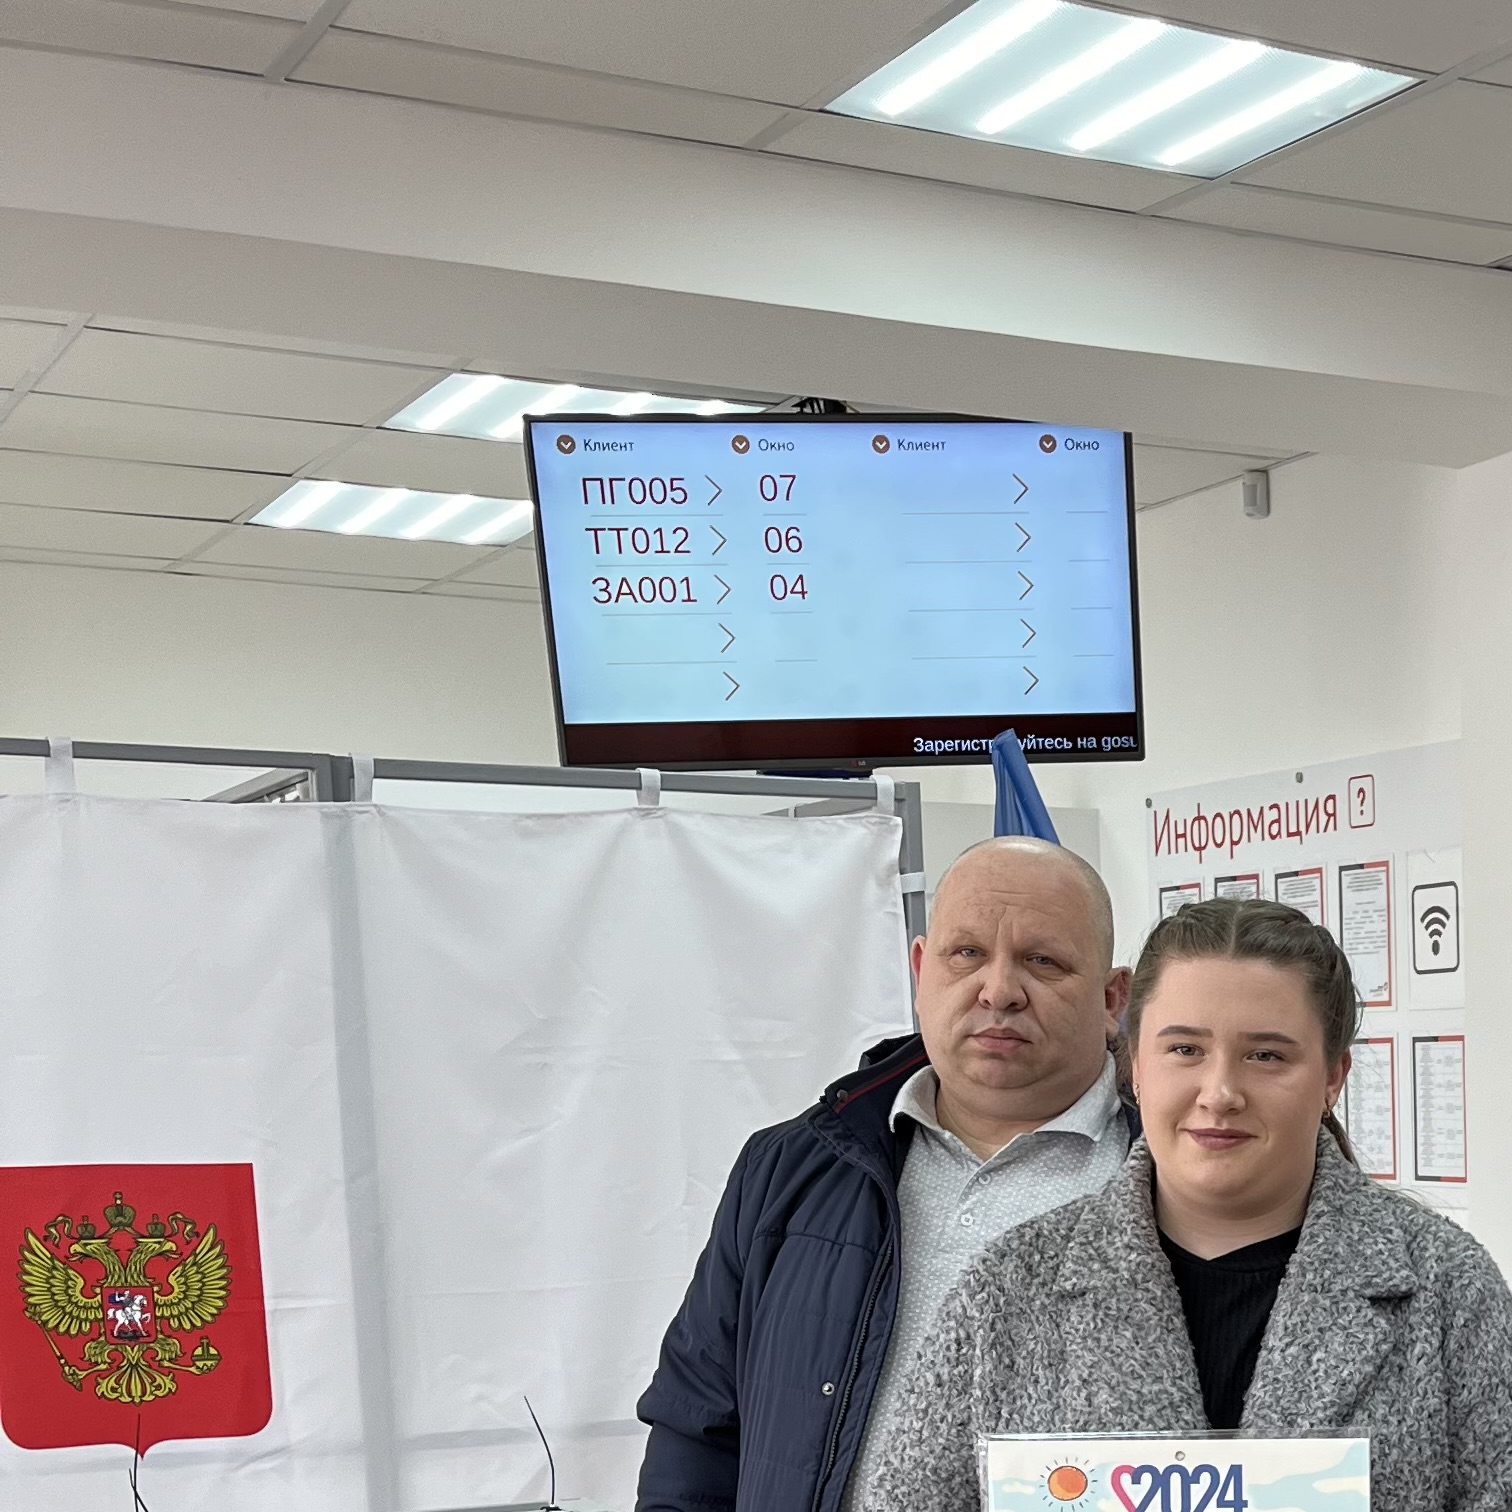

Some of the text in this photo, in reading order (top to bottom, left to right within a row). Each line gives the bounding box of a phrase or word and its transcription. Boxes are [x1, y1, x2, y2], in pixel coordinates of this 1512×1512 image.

[583, 438, 1100, 452] Клиент Окно Клиент Окно
[581, 474, 796, 505] ПГ005 07
[584, 526, 803, 555] ТТ012 06
[769, 573, 808, 601] 04
[913, 734, 1072, 756] Зарегистуйтесь
[1077, 736, 1098, 749] на
[1153, 793, 1338, 864] Информация
